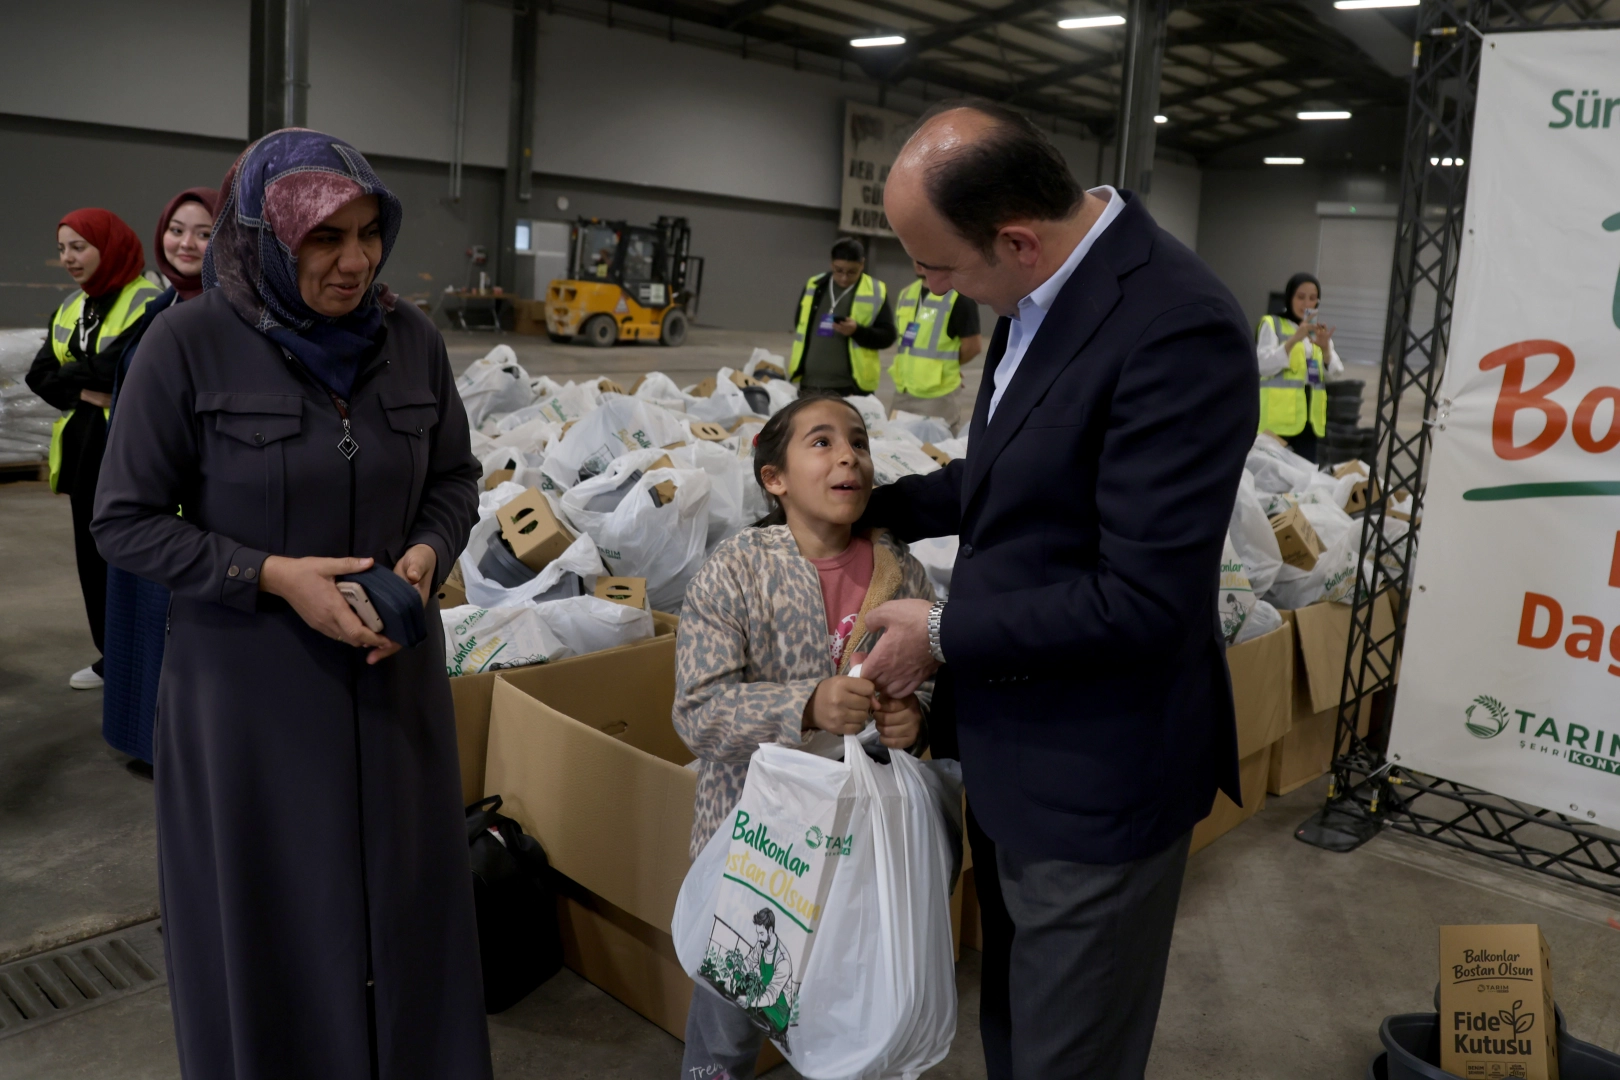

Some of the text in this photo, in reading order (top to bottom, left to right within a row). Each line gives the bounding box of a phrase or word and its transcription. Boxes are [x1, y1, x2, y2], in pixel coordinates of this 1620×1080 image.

[732, 809, 810, 878] Balkonlar
[726, 850, 821, 921] stan Olsun
[1463, 949, 1520, 963] Balkonlar
[1452, 962, 1533, 979] Bostan Olsun
[1454, 1011, 1500, 1031] Fide
[1454, 1033, 1532, 1055] Kutusu
